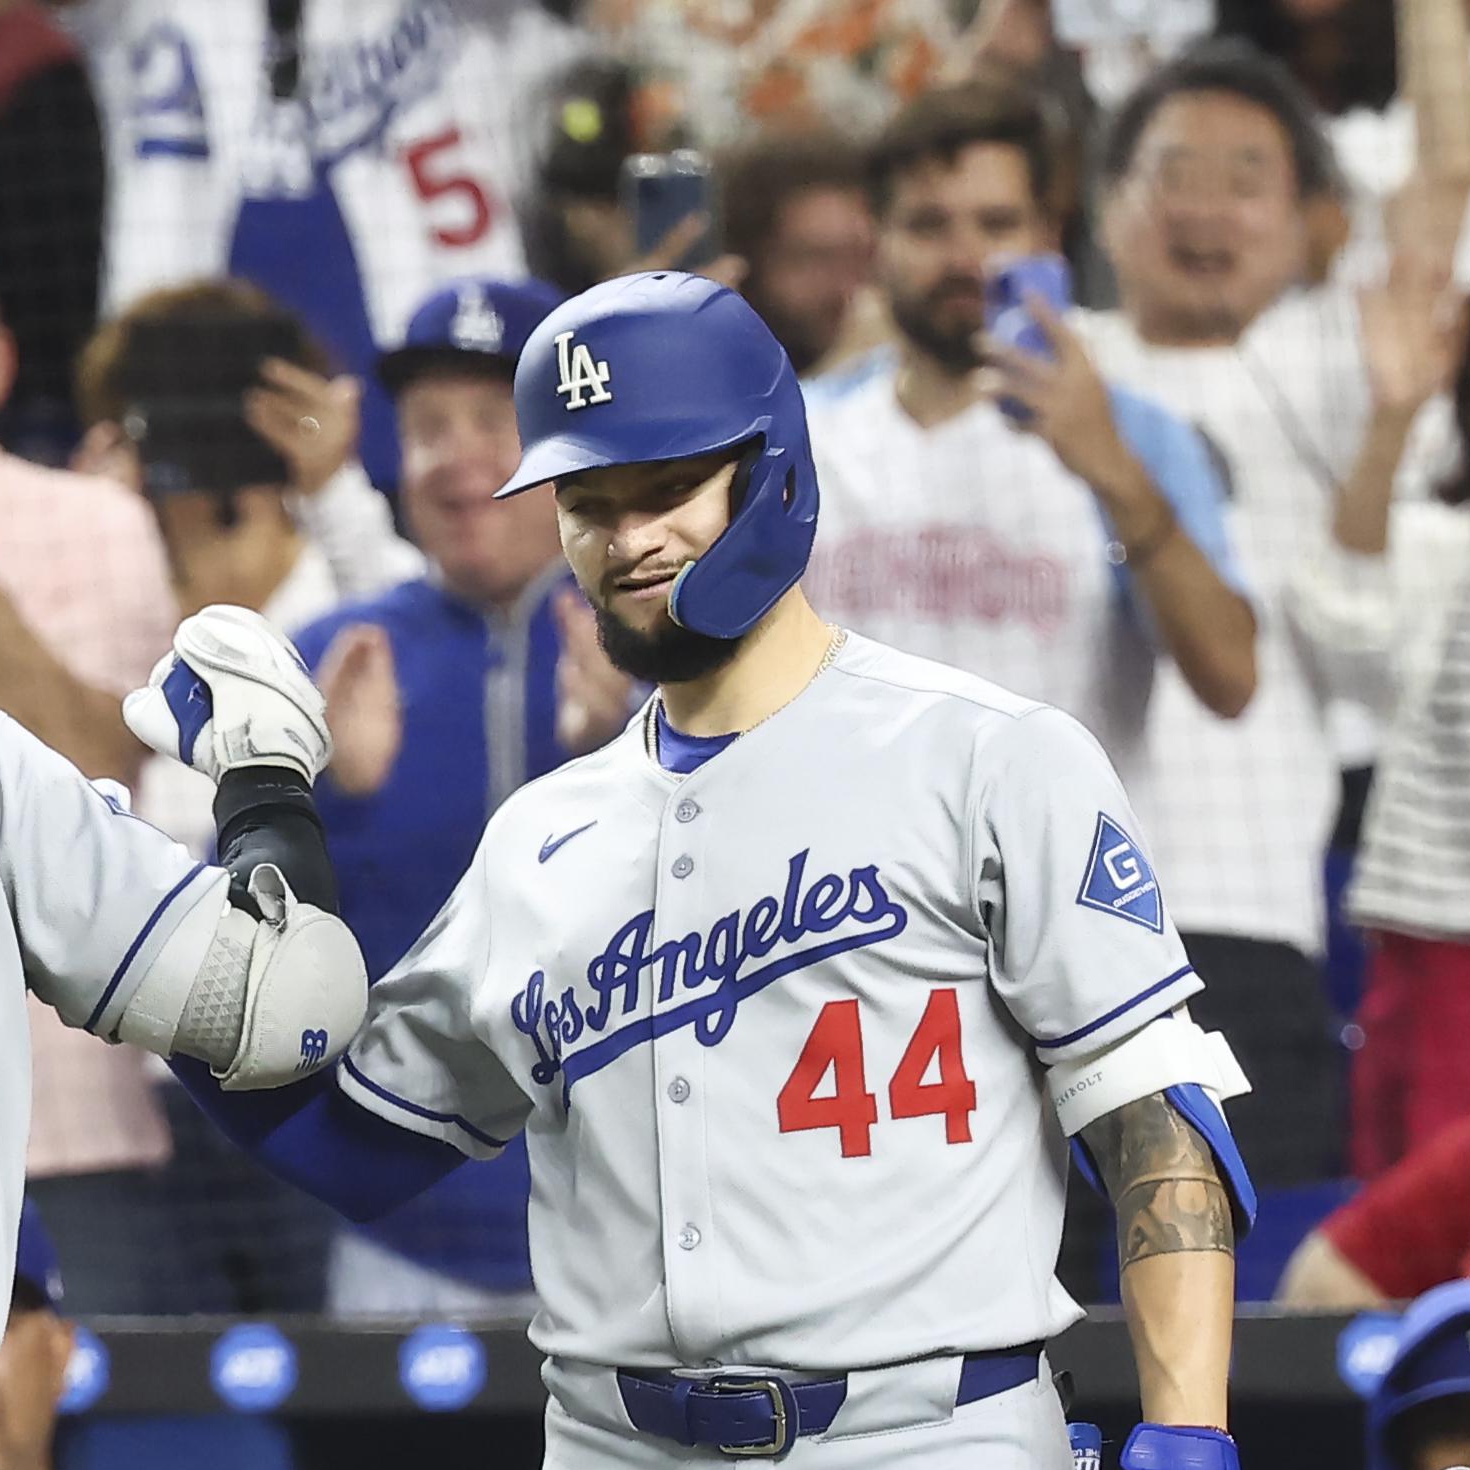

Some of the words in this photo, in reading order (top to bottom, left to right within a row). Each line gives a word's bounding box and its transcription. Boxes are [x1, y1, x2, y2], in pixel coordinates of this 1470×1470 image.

[402, 122, 494, 250] 5
[554, 331, 613, 412] LA
[1103, 841, 1143, 890] G
[511, 969, 586, 1086] Los
[586, 847, 908, 1048] Angeles
[776, 987, 978, 1159] 44
